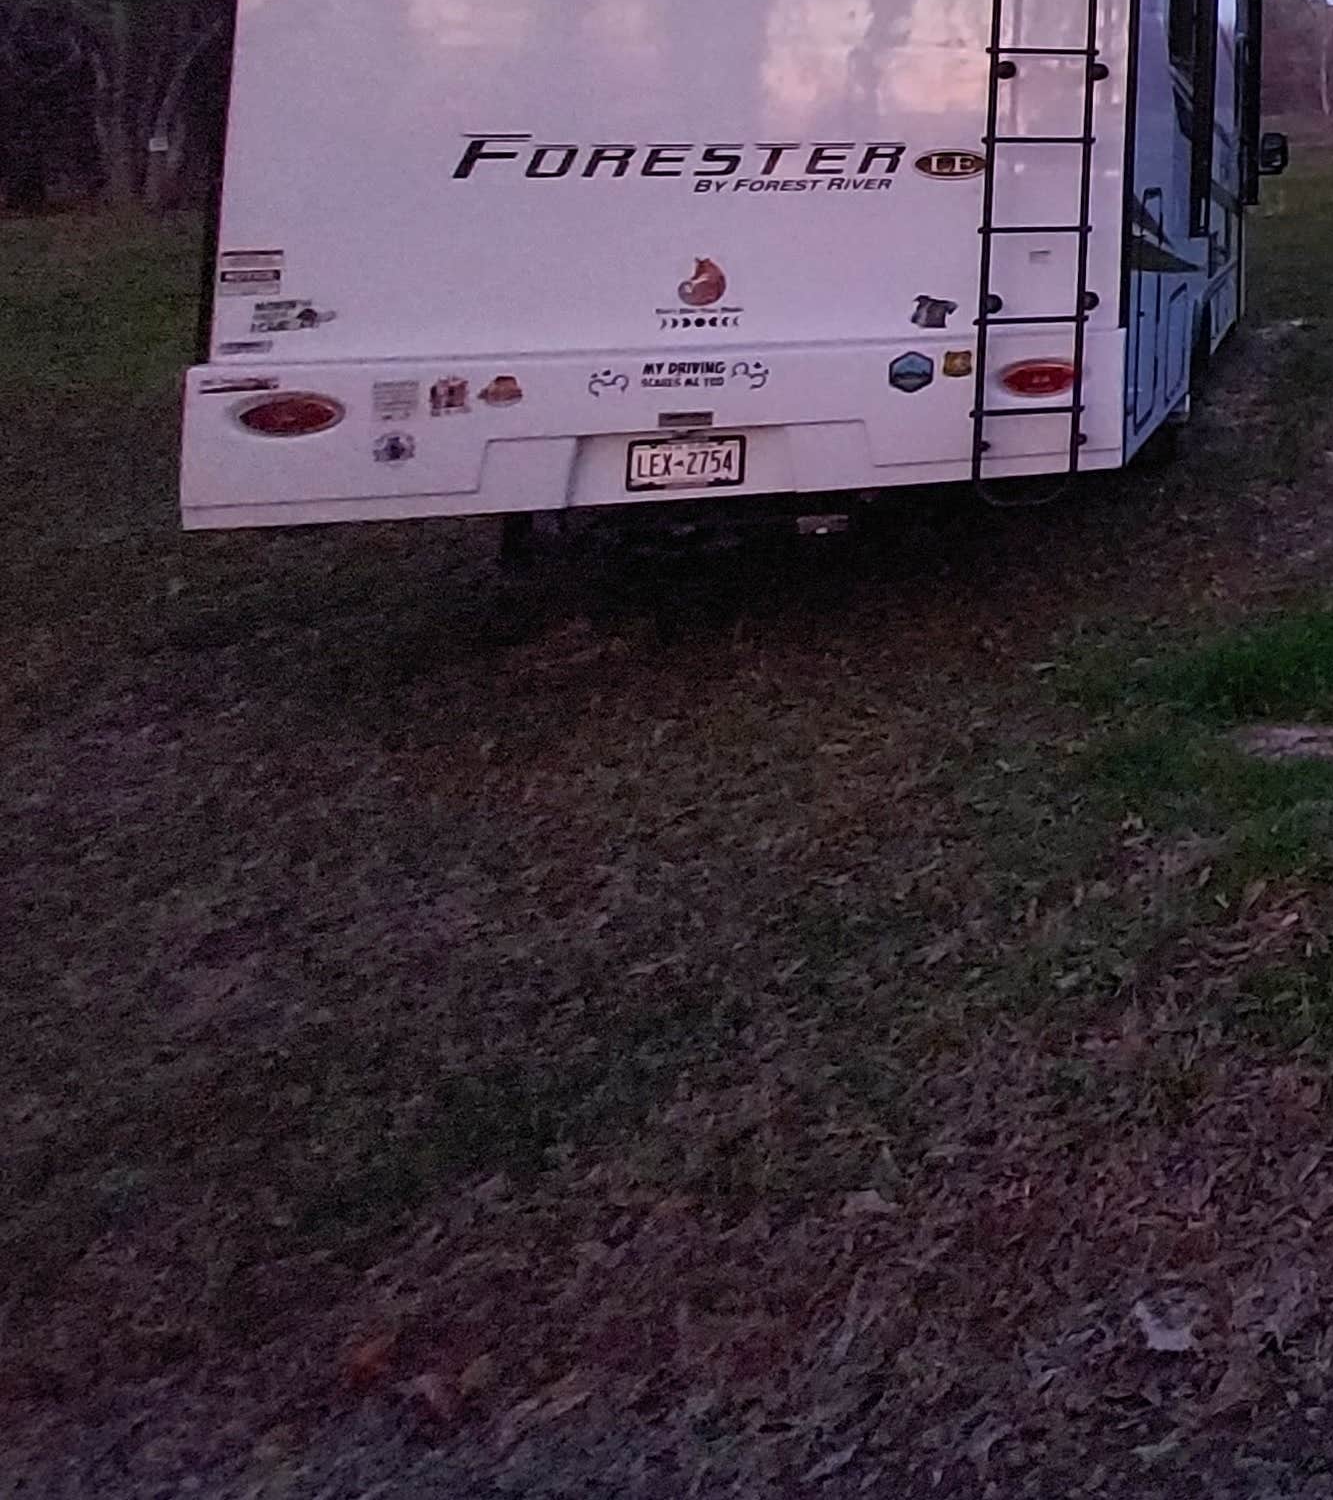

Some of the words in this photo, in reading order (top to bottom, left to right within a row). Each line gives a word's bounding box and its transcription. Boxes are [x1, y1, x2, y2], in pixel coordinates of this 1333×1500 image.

[452, 132, 907, 180] FORESTER
[693, 179, 728, 193] BY
[732, 178, 821, 192] FOREST
[826, 177, 893, 191] RIVER
[642, 362, 665, 375] MY
[668, 361, 727, 375] DRIVING
